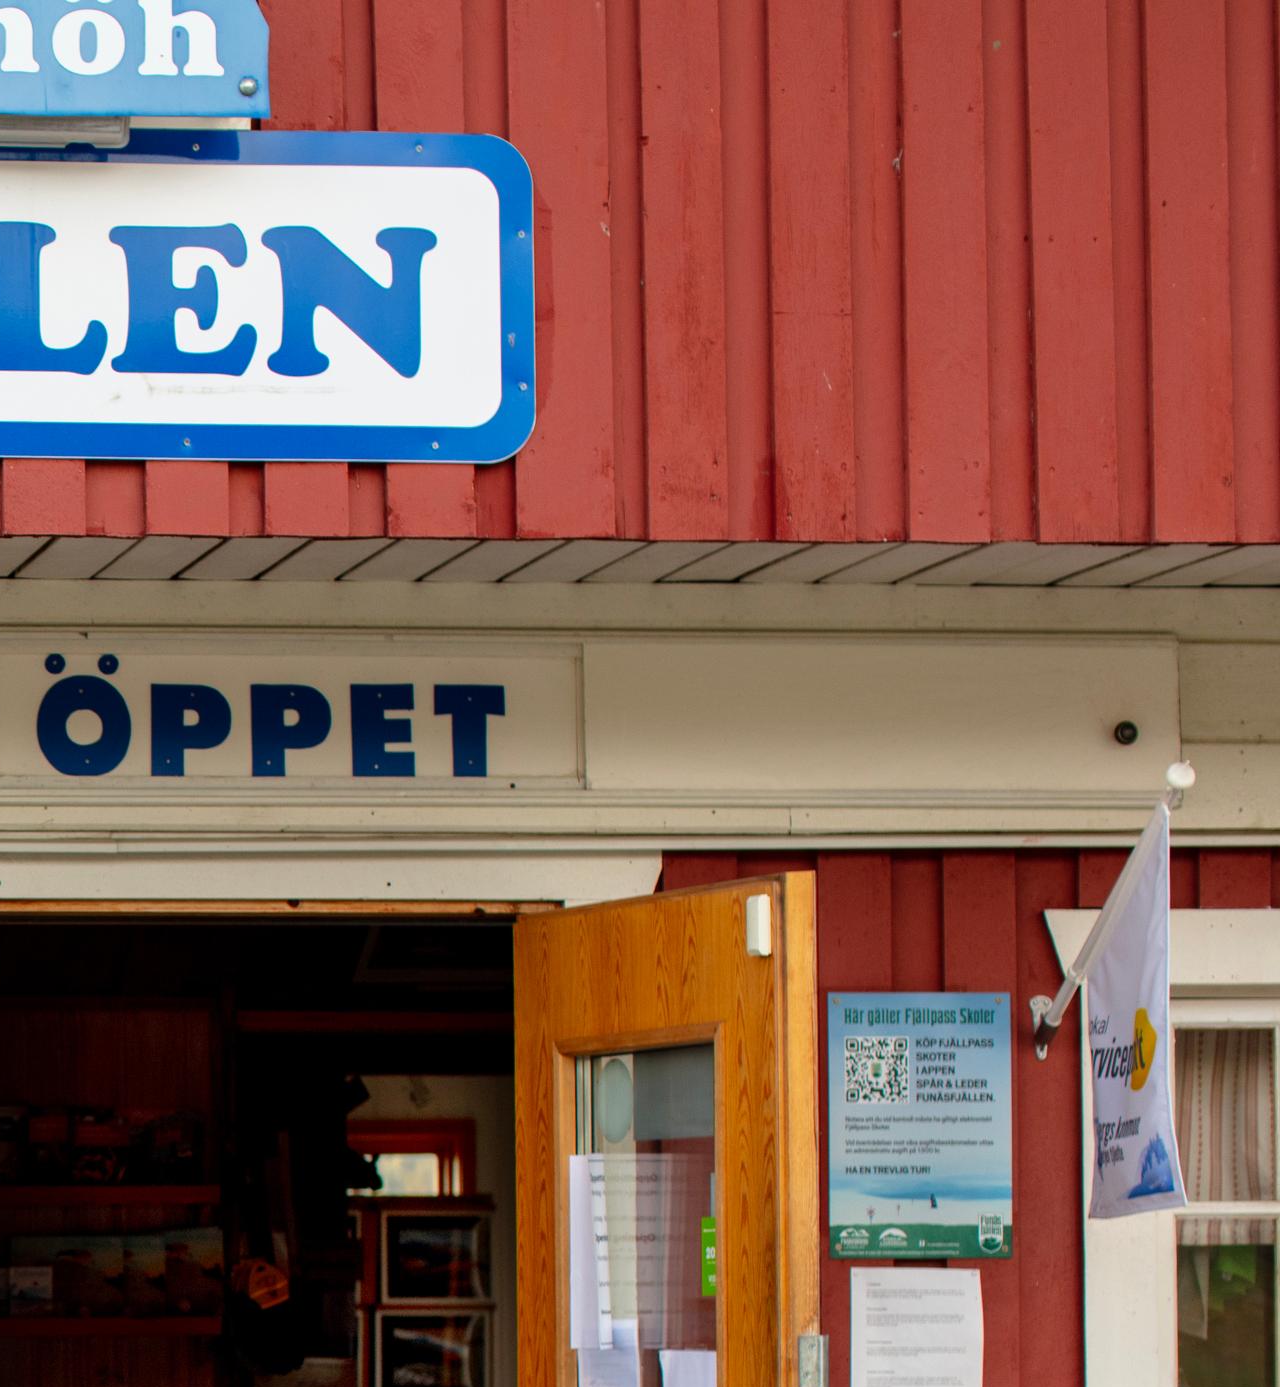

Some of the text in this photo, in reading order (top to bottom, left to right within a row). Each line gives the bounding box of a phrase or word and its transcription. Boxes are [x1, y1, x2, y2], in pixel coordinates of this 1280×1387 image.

[37, 653, 506, 777] ÖPPET
[844, 1007, 995, 1026] Här gäller Fjällpass Skoter
[916, 1037, 995, 1048] KÖP FJÄLLPASS
[916, 1052, 956, 1061] SKOTER
[920, 1066, 955, 1075] APPEN
[916, 1078, 988, 1089] SPÅR & LEDER
[845, 1166, 858, 1174] HA
[859, 1166, 871, 1174] EN
[873, 1166, 909, 1174] TREVLIG
